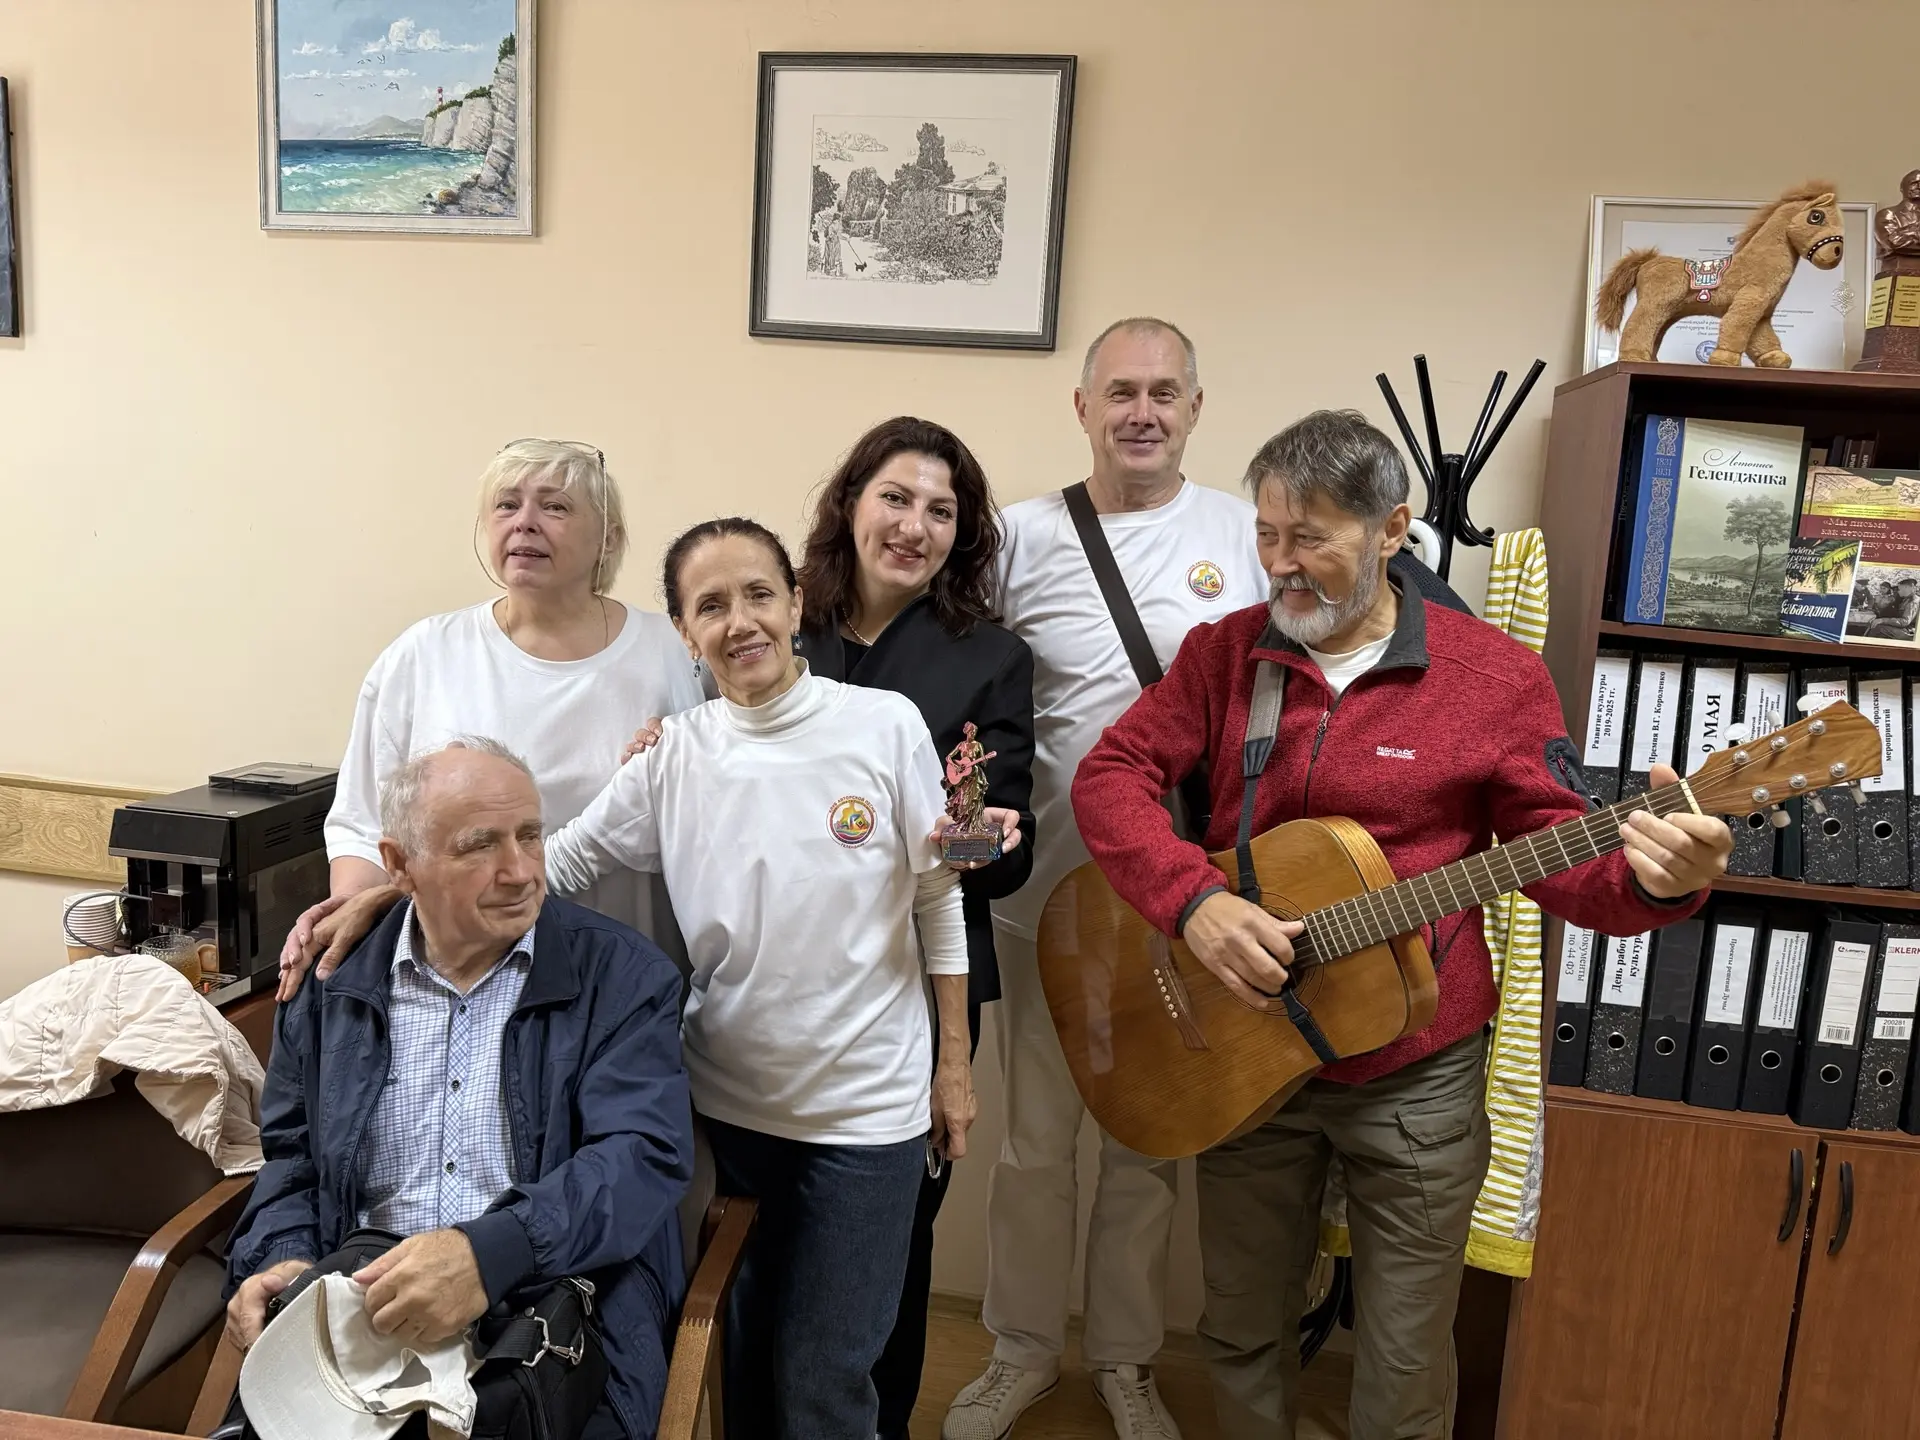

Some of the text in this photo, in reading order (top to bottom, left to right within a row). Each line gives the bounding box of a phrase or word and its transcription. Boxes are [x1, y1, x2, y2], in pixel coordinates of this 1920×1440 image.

[1655, 467, 1671, 476] 1931
[1688, 465, 1787, 486] Геленджика
[1703, 448, 1774, 468] Летопись
[1821, 528, 1839, 536] как
[1840, 529, 1887, 539] летопись
[1592, 674, 1608, 749] Развитие культуры
[1819, 689, 1846, 698] LERK
[1604, 699, 1614, 737] 2019-2025
[1649, 671, 1666, 763] Премия В.Г. Короленко
[1702, 694, 1721, 753] 9 МАЯ
[1883, 708, 1893, 762] мероприятий
[1565, 934, 1576, 975] по 44 ФЗ
[1611, 938, 1627, 993] День работ
[1630, 935, 1643, 977] культур
[1729, 938, 1737, 965] Проекты
